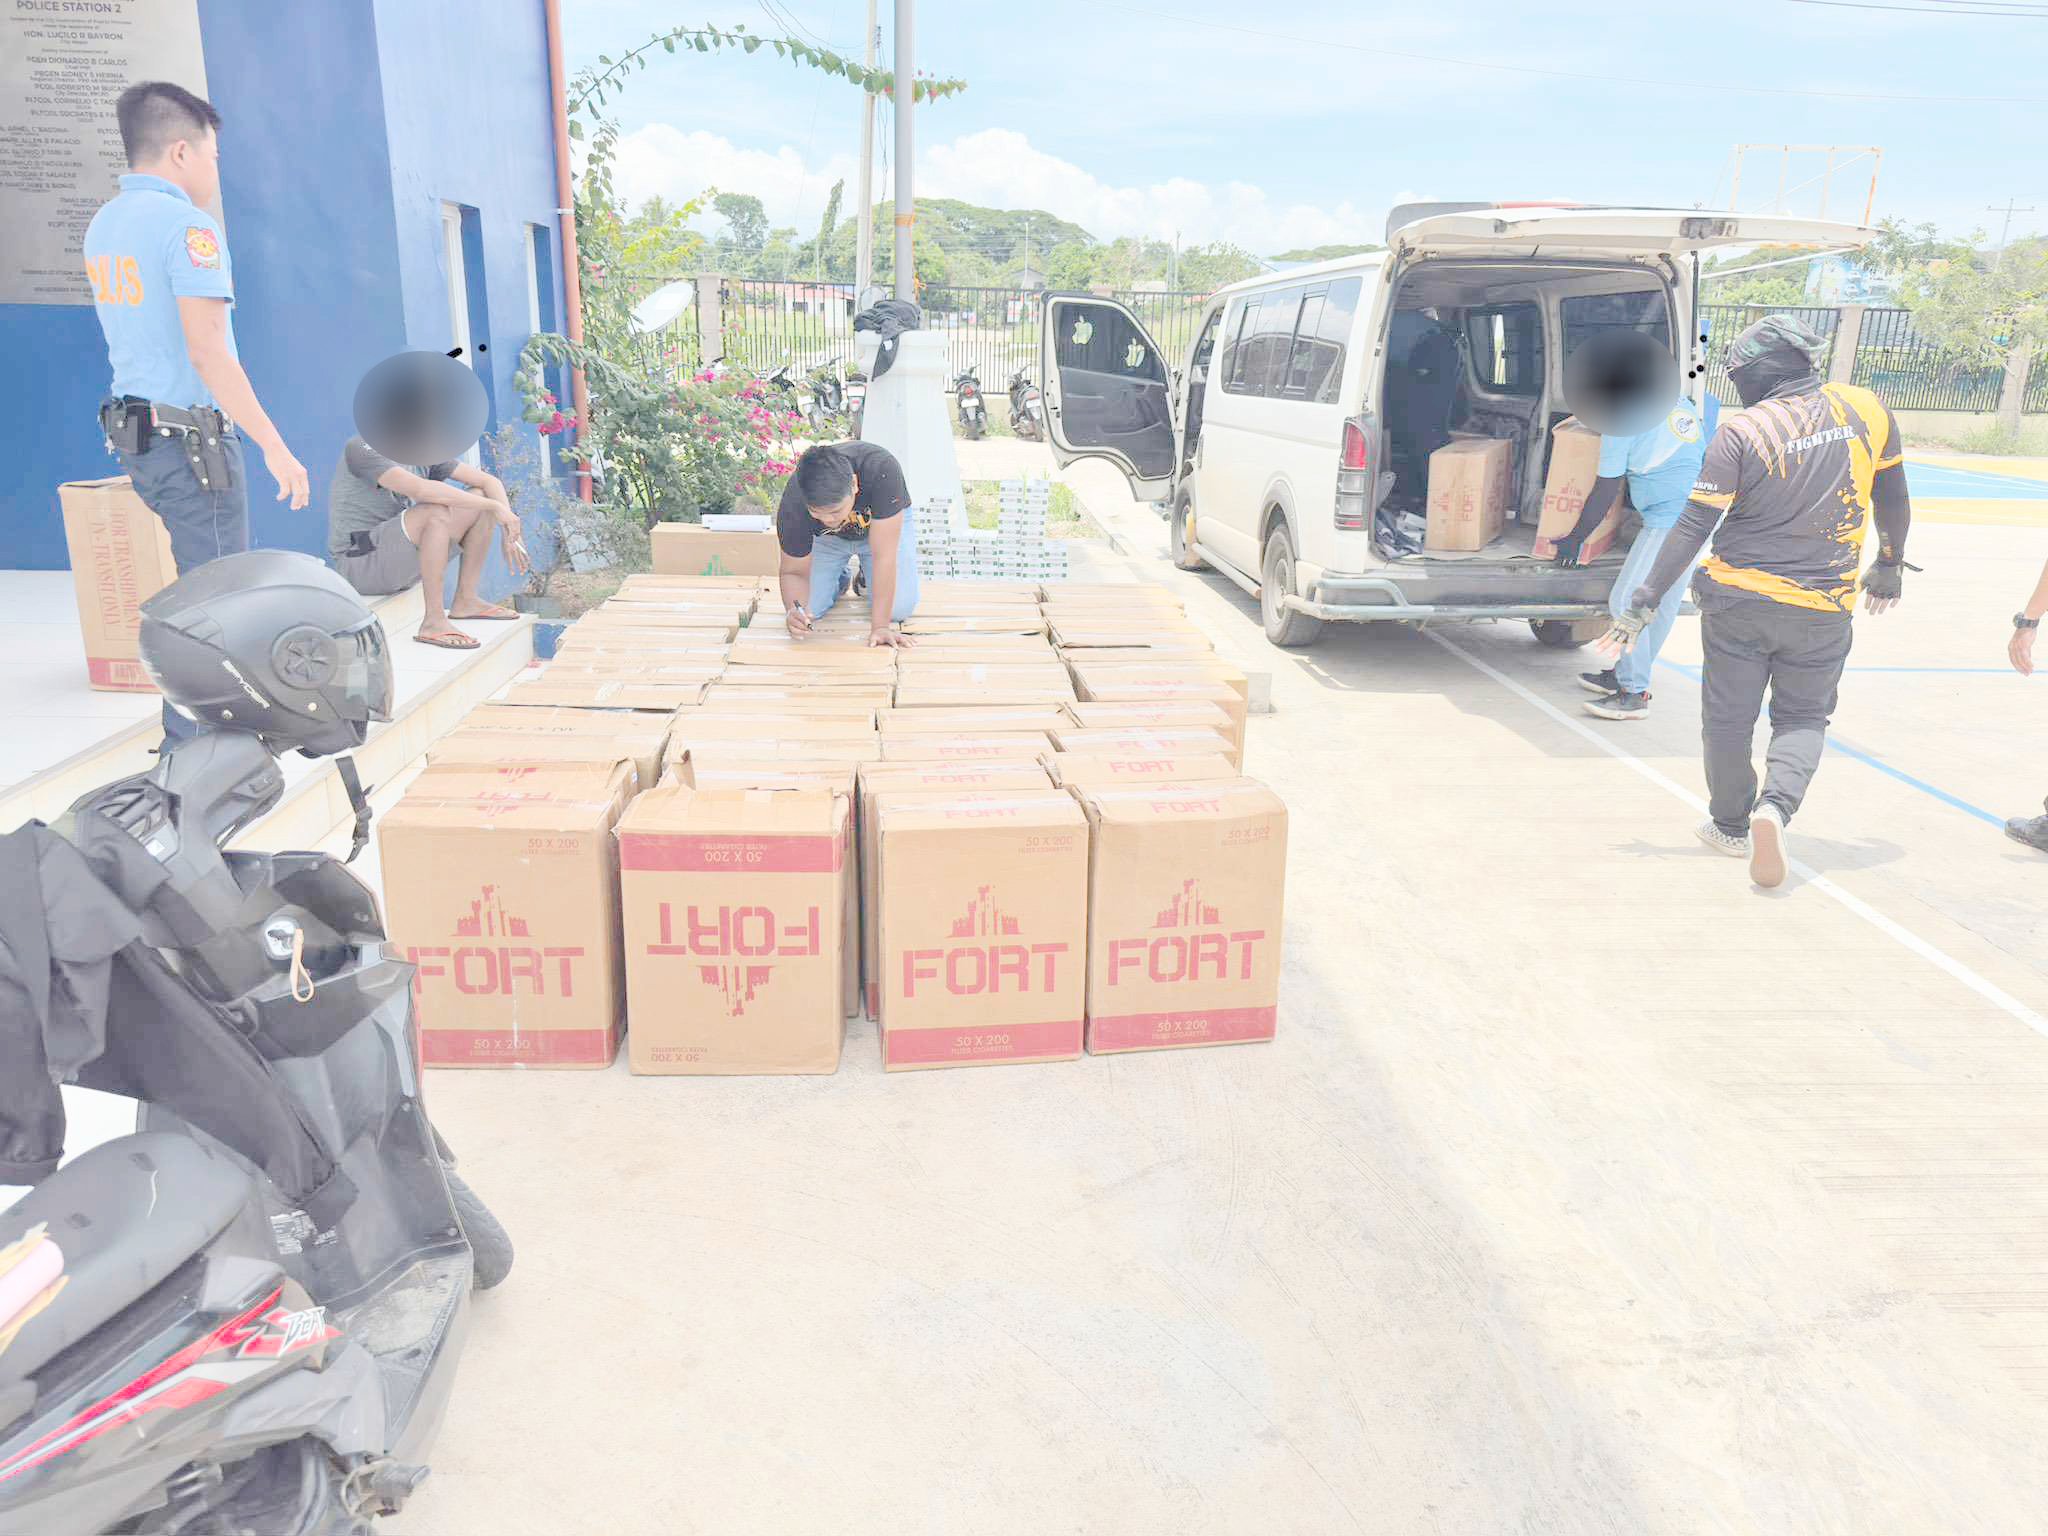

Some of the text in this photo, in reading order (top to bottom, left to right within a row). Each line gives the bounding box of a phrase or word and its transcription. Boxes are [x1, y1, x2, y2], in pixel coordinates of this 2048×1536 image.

[16, 0, 122, 13] POLICE STATION 2
[87, 32, 123, 40] BAYRON
[1786, 425, 1855, 454] FIGHTER
[1543, 495, 1584, 513] FOR
[1109, 759, 1176, 773] FORT
[1151, 799, 1221, 814] FORT
[528, 838, 542, 849] 50
[557, 838, 580, 849] 200
[1025, 836, 1040, 847] 50
[1052, 835, 1073, 846] 200
[704, 851, 763, 863] 50 X 200
[646, 903, 820, 956] FORT
[1107, 930, 1265, 986] FORT
[405, 946, 584, 997] FORT
[903, 942, 1069, 998] FORT
[1158, 1019, 1208, 1032] 50 X 200
[472, 1039, 531, 1049] 50 X 200
[955, 1034, 1009, 1047] 50 X 200
